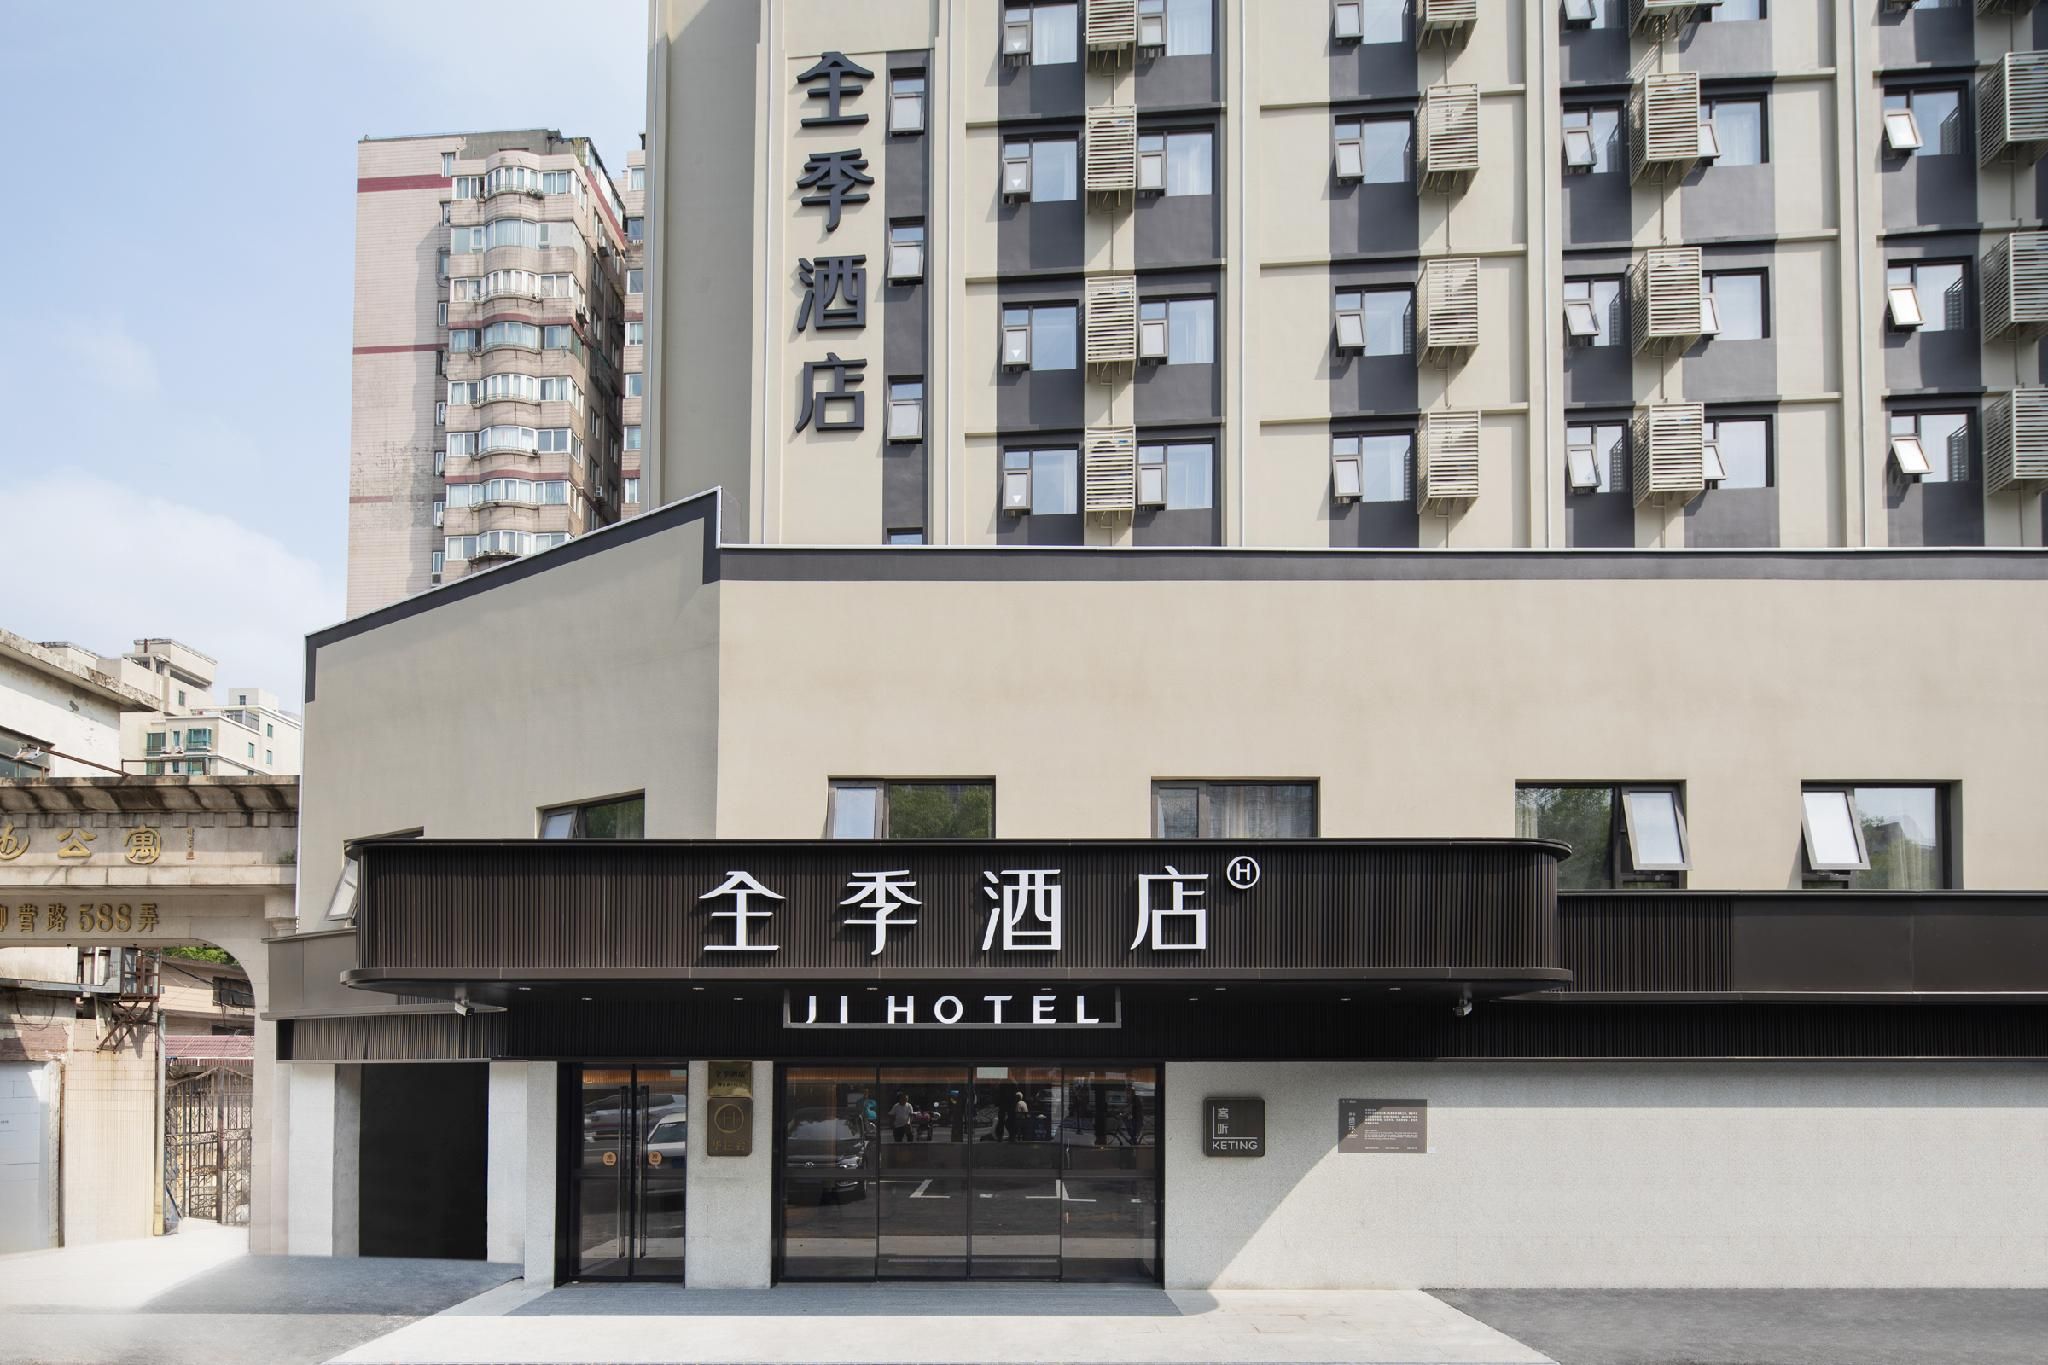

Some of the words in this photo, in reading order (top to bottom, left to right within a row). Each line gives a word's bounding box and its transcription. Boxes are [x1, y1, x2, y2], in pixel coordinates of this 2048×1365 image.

[797, 51, 875, 433] 全季酒店
[699, 865, 1210, 955] 全季酒店
[805, 996, 848, 1024] JI
[886, 996, 1100, 1024] HOTEL
[1212, 1140, 1258, 1150] KETING
